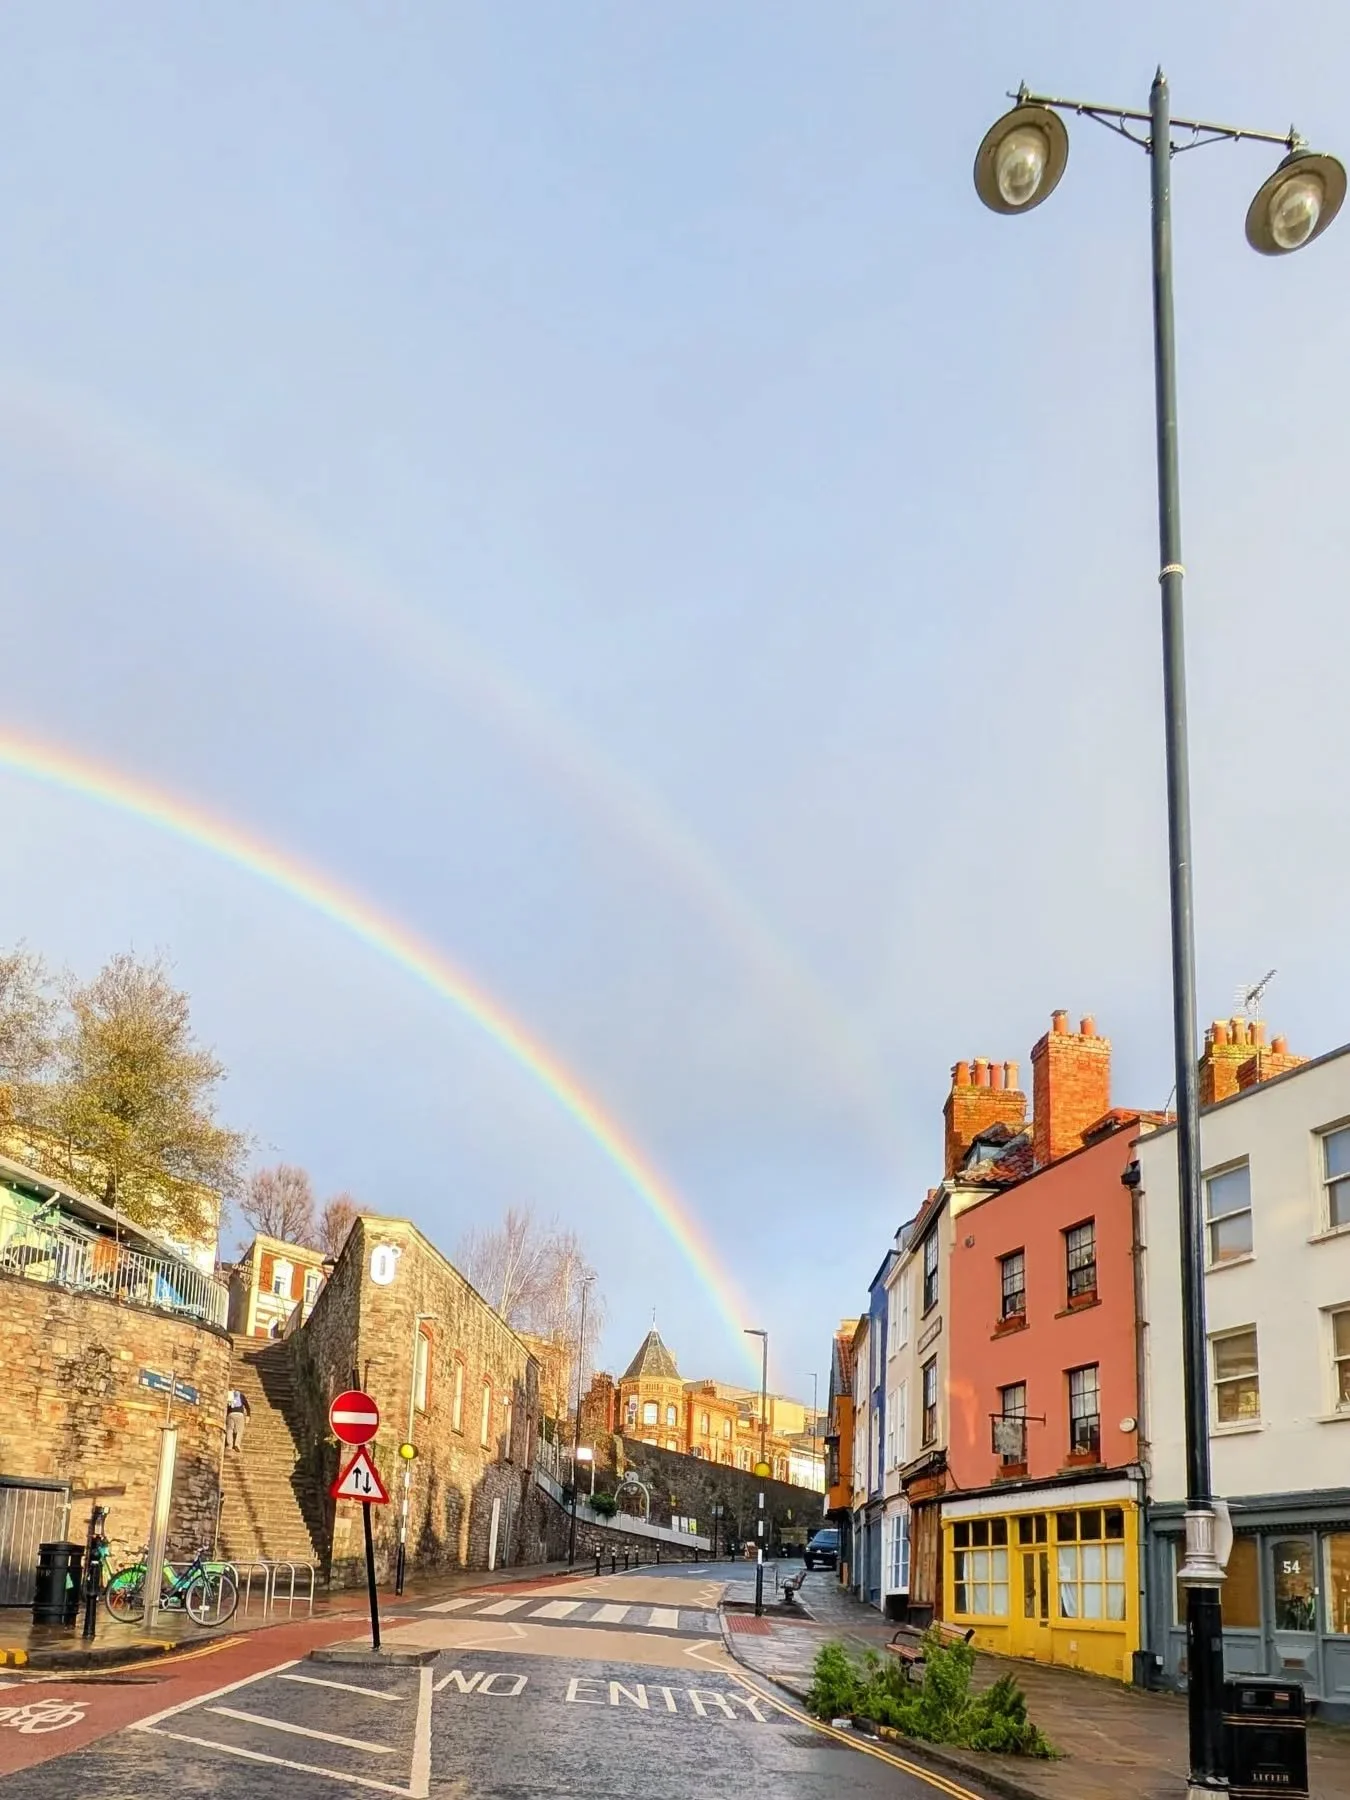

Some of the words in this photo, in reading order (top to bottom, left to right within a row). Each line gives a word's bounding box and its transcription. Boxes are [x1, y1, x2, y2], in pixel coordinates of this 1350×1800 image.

[1283, 1560, 1301, 1574] 54
[432, 1669, 528, 1697] NO
[566, 1677, 767, 1723] ENTRY
